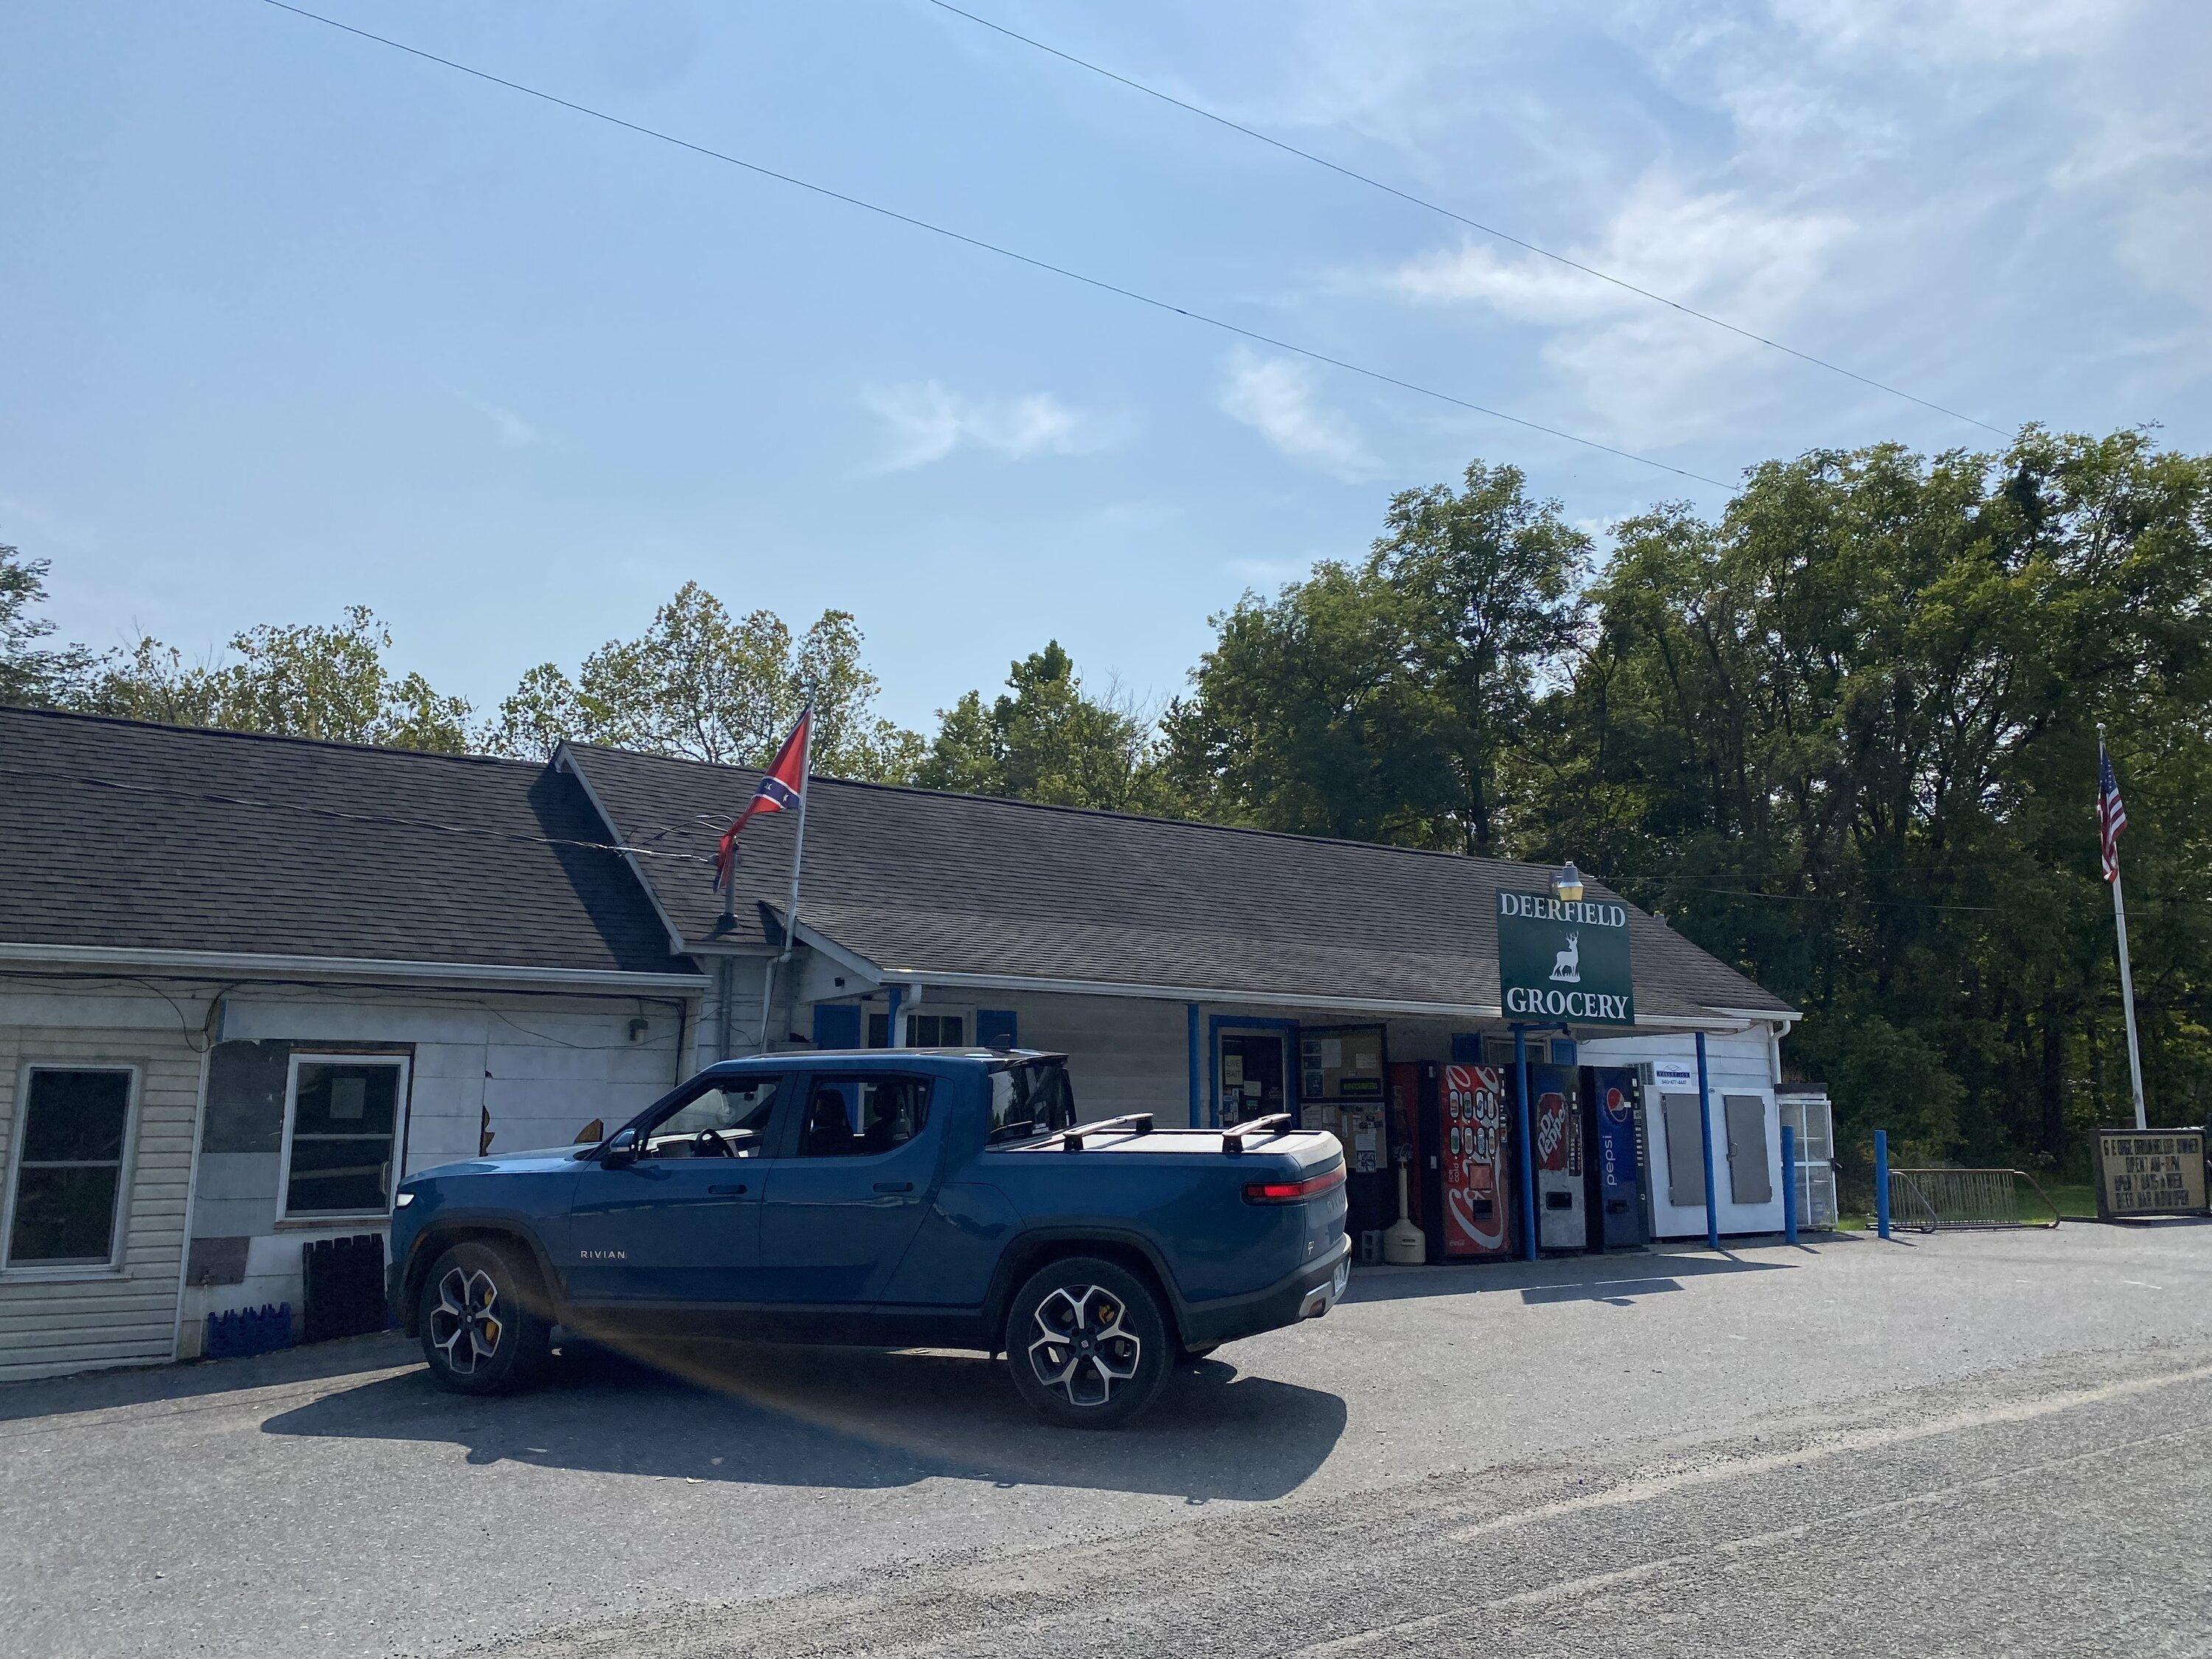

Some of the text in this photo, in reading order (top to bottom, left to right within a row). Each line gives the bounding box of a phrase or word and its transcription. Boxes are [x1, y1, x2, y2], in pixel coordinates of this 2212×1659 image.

[1500, 893, 1626, 928] DEERFIELD
[1506, 987, 1629, 1020] GROCERY
[1538, 1102, 1565, 1163] Pepper
[1540, 1108, 1554, 1136] Dr
[1602, 1135, 1617, 1186] pepsi
[580, 1251, 625, 1259] RIVIAN
